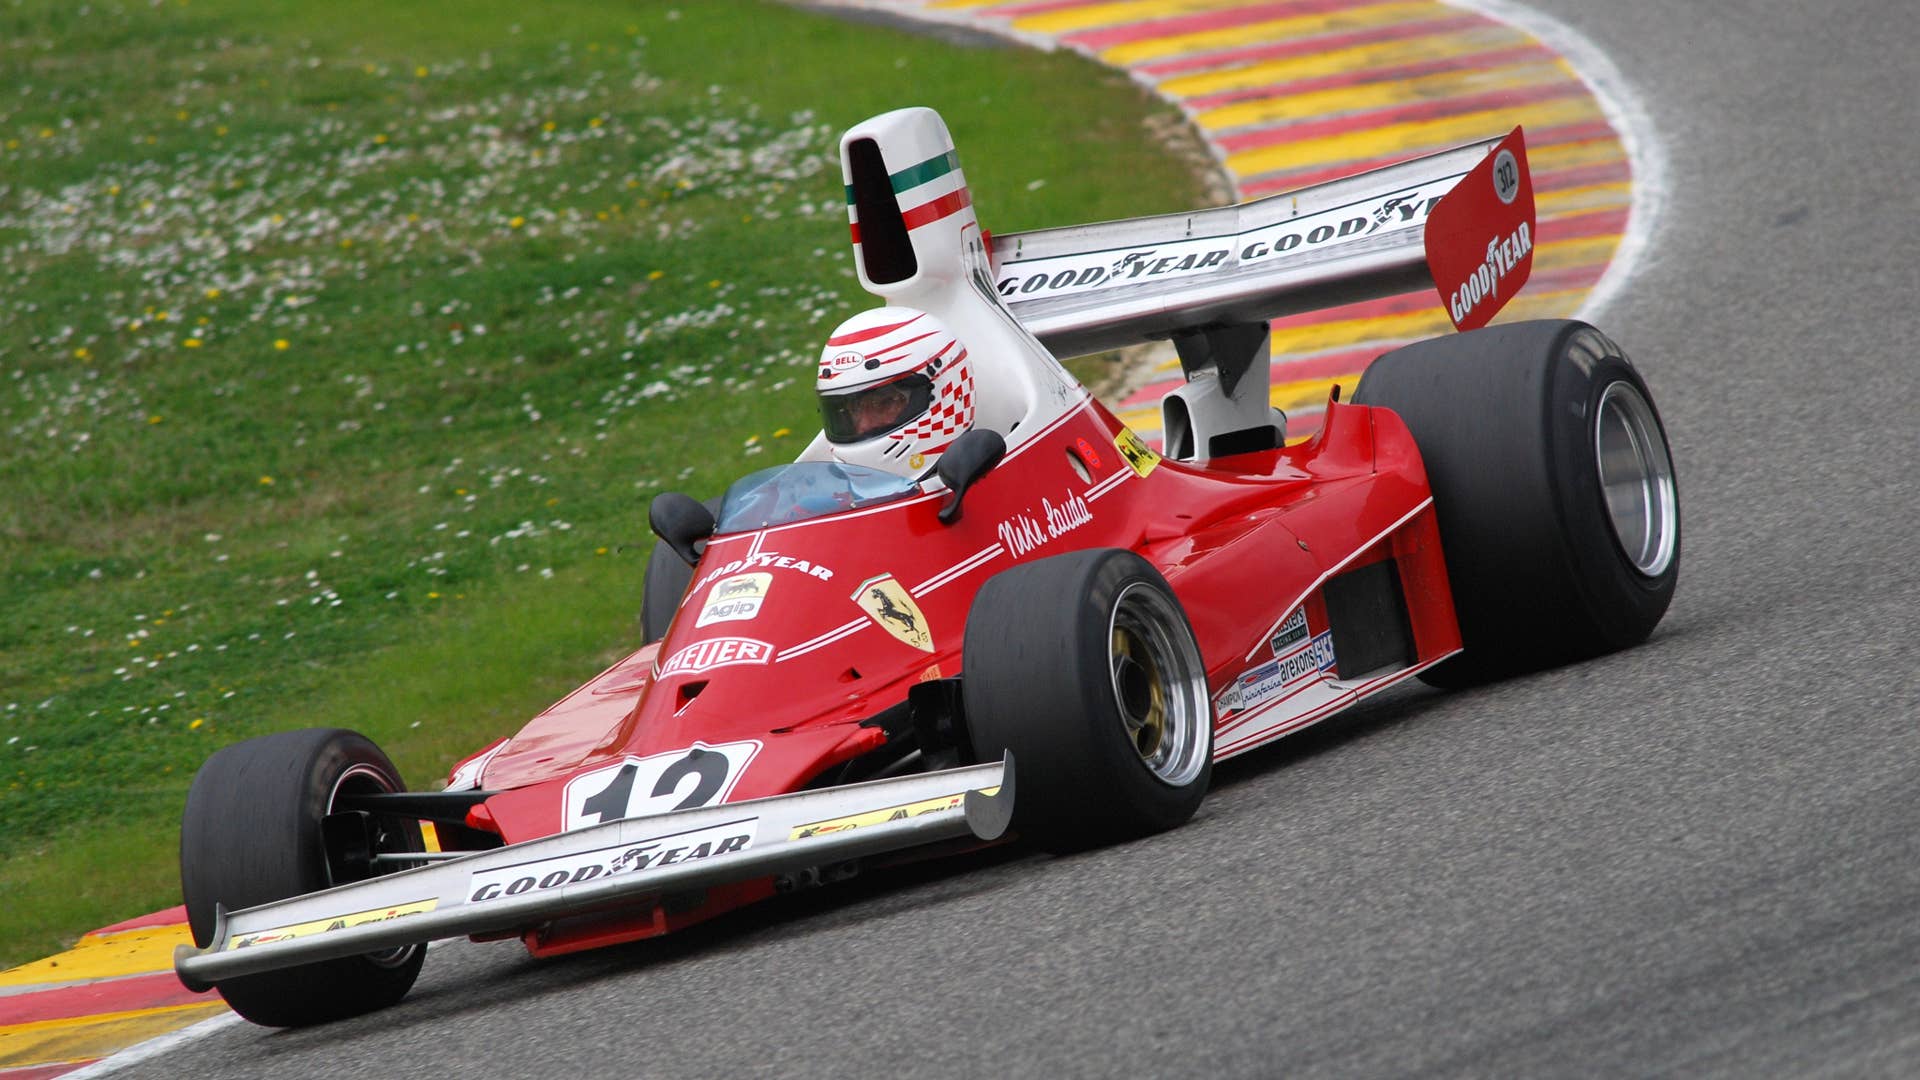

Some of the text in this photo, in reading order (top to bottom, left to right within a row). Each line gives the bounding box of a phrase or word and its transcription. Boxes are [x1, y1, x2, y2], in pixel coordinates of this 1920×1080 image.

[1498, 160, 1516, 193] 312
[835, 356, 857, 365] BELL
[1042, 487, 1093, 539] Lauda
[704, 601, 756, 620] Agip
[666, 640, 761, 673] HEUER
[1280, 648, 1316, 682] arexons
[1217, 691, 1241, 710] CHAMPION
[581, 748, 729, 823] 12
